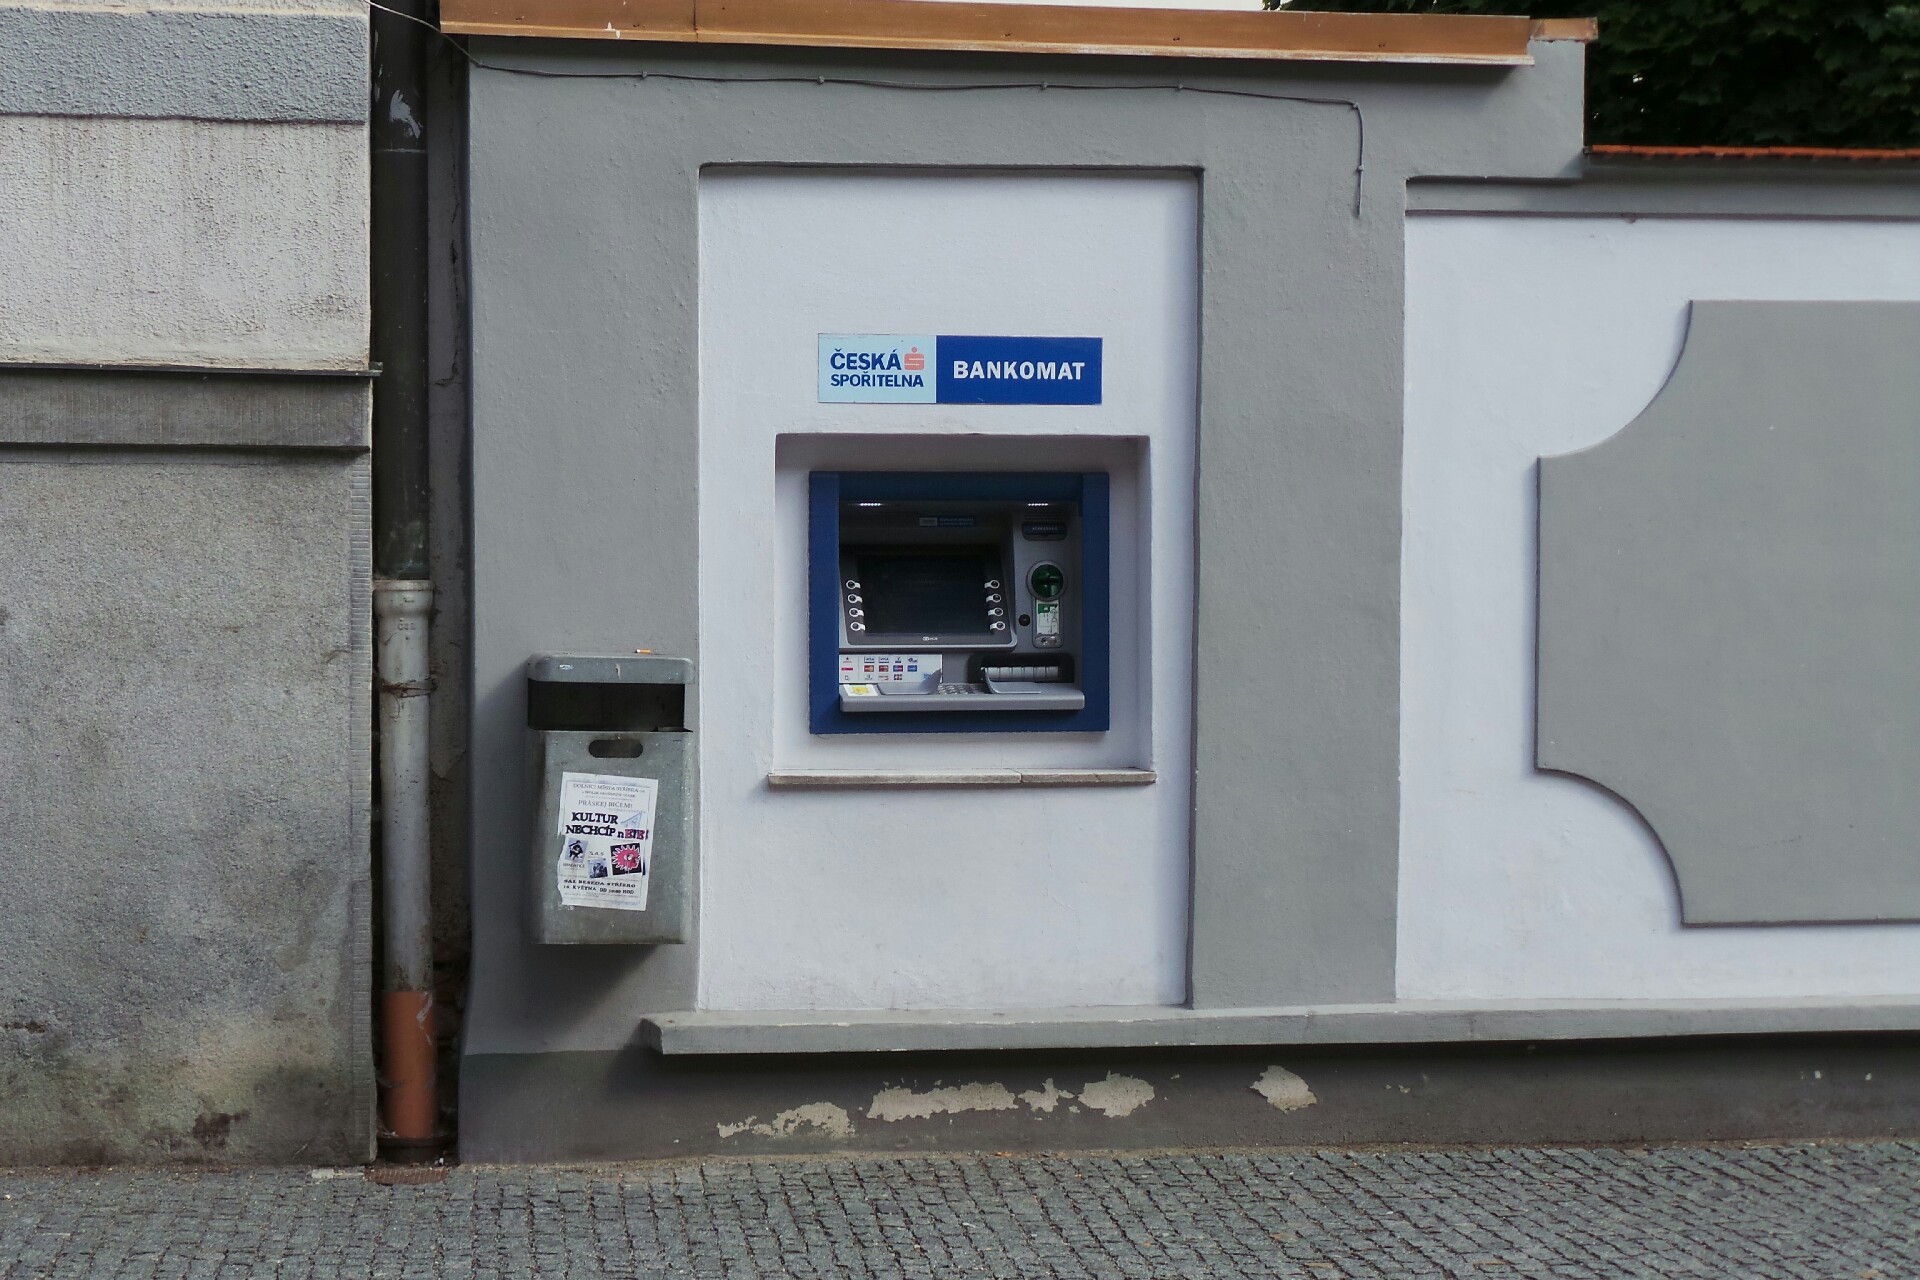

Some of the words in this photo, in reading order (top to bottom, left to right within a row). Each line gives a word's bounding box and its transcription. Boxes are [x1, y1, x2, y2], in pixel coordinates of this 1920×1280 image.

[830, 348, 901, 371] ČESKÁ
[953, 360, 1085, 380] BANKOMAT
[830, 371, 925, 388] SPOŘITELNA
[571, 812, 619, 825] KULTUR
